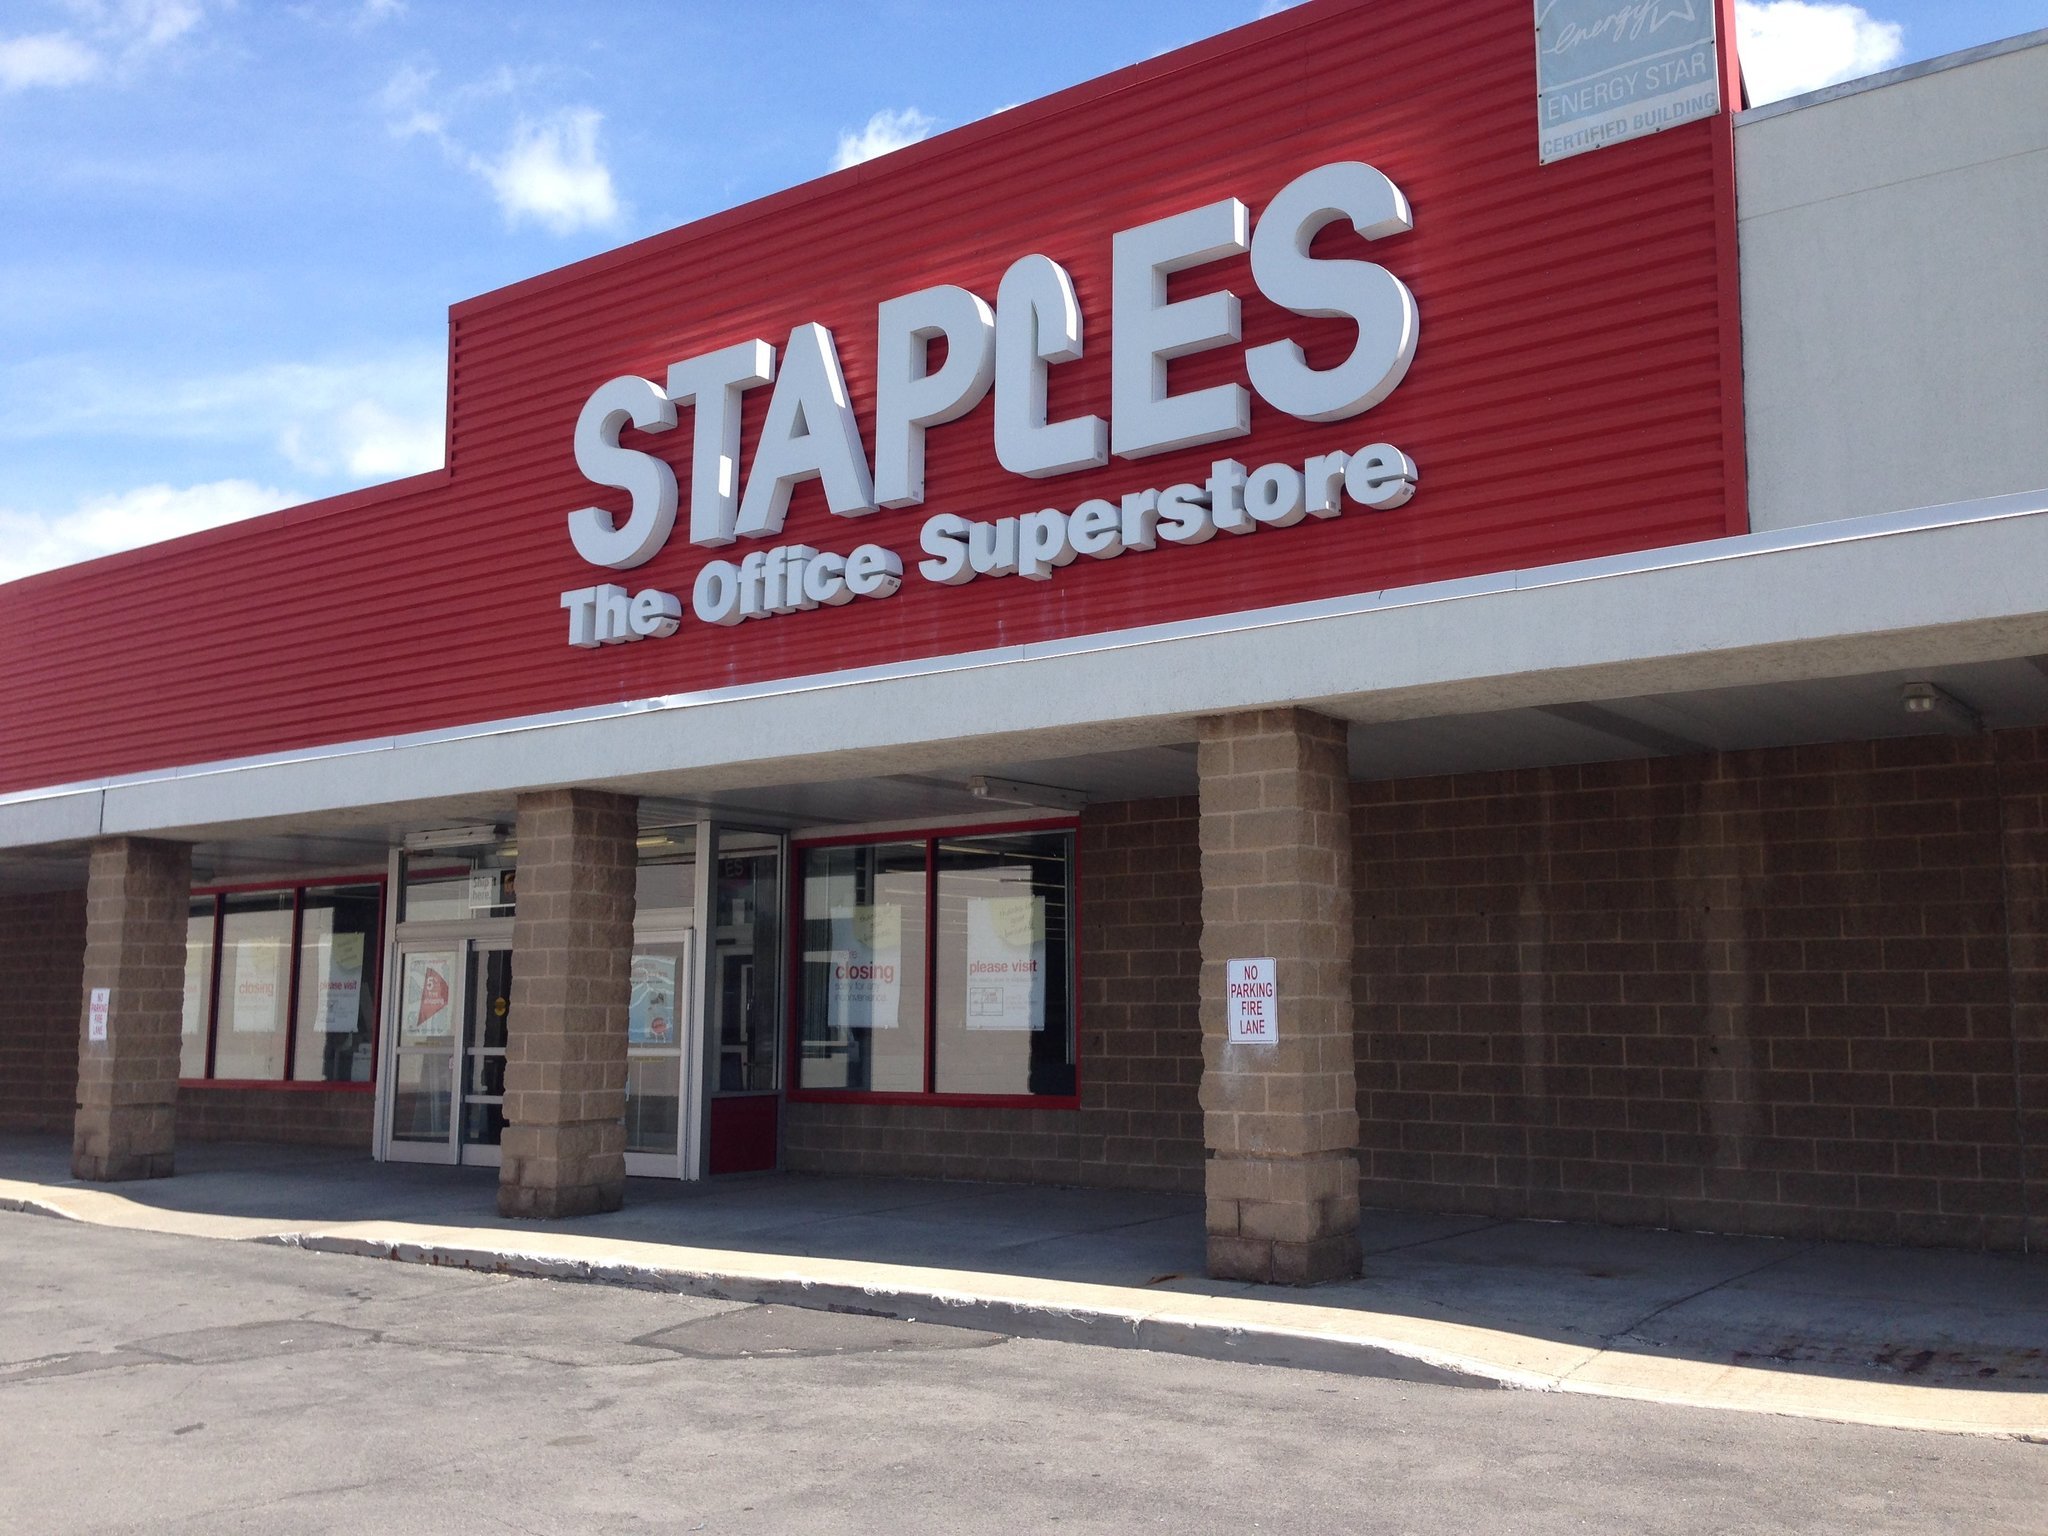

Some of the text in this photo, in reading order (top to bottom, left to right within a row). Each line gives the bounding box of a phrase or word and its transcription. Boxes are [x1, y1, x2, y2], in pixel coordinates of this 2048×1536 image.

[1549, 52, 1707, 121] ENERGY STAR
[1542, 92, 1716, 156] CERTIFIED BUILDING
[567, 161, 1420, 570] STAPLES
[561, 442, 1419, 648] The Office Superstore
[835, 961, 895, 984] closing
[969, 960, 1037, 975] please visit
[1244, 965, 1258, 980] NO
[1231, 982, 1273, 998] PARKING
[1241, 1000, 1263, 1016] FIRE
[1240, 1019, 1266, 1034] LANE
